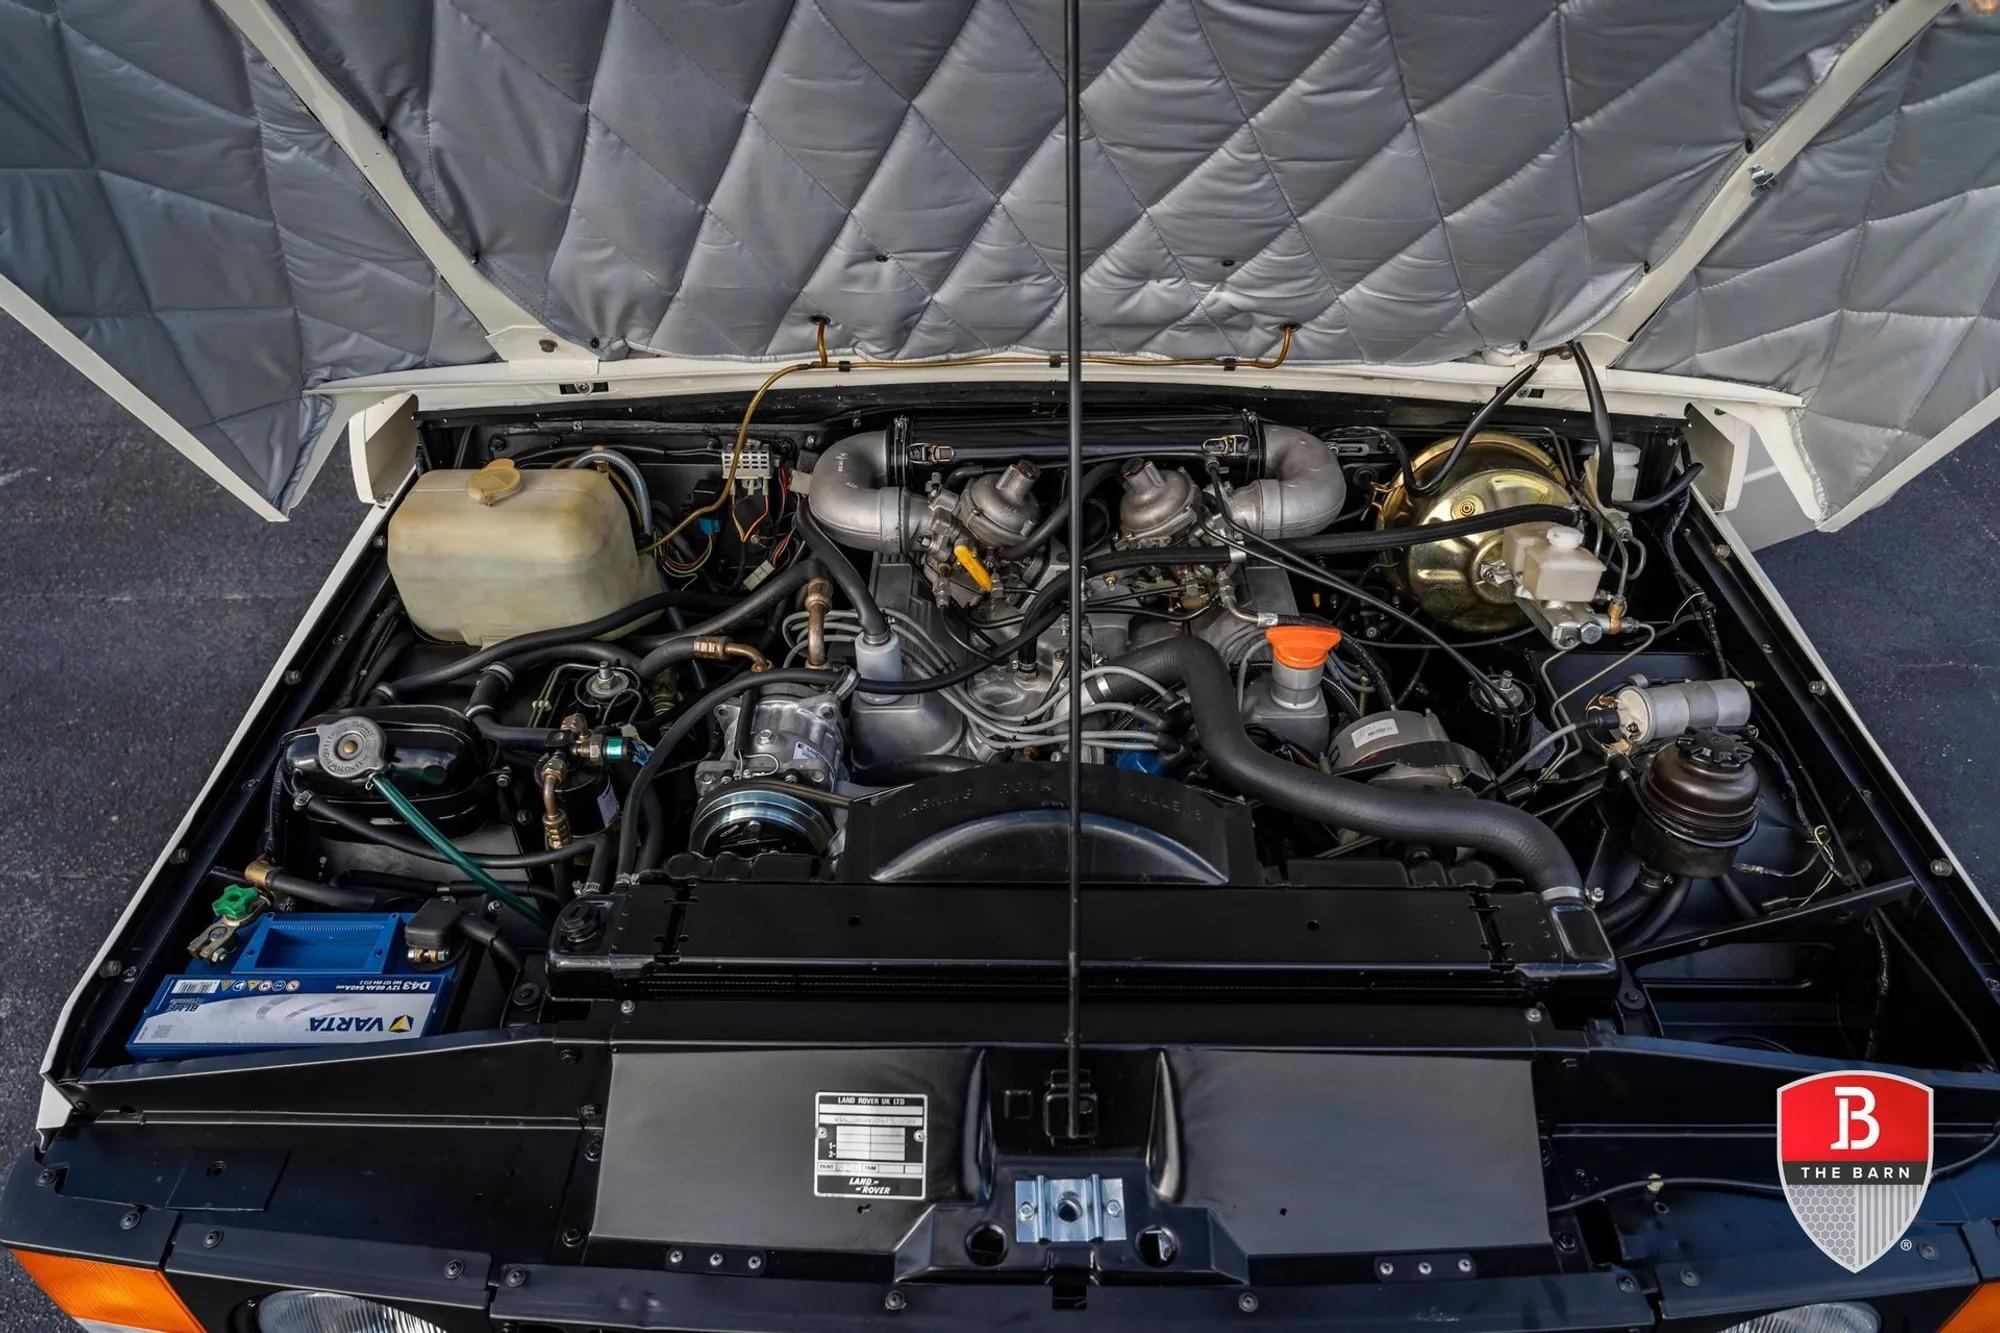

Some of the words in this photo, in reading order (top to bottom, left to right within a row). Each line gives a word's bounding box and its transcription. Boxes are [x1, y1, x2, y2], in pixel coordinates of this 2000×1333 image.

[402, 981, 431, 991] D43
[309, 1017, 384, 1032] VARTA
[858, 1097, 879, 1105] ROVER
[881, 1097, 891, 1105] UK
[893, 1097, 906, 1105] LTD
